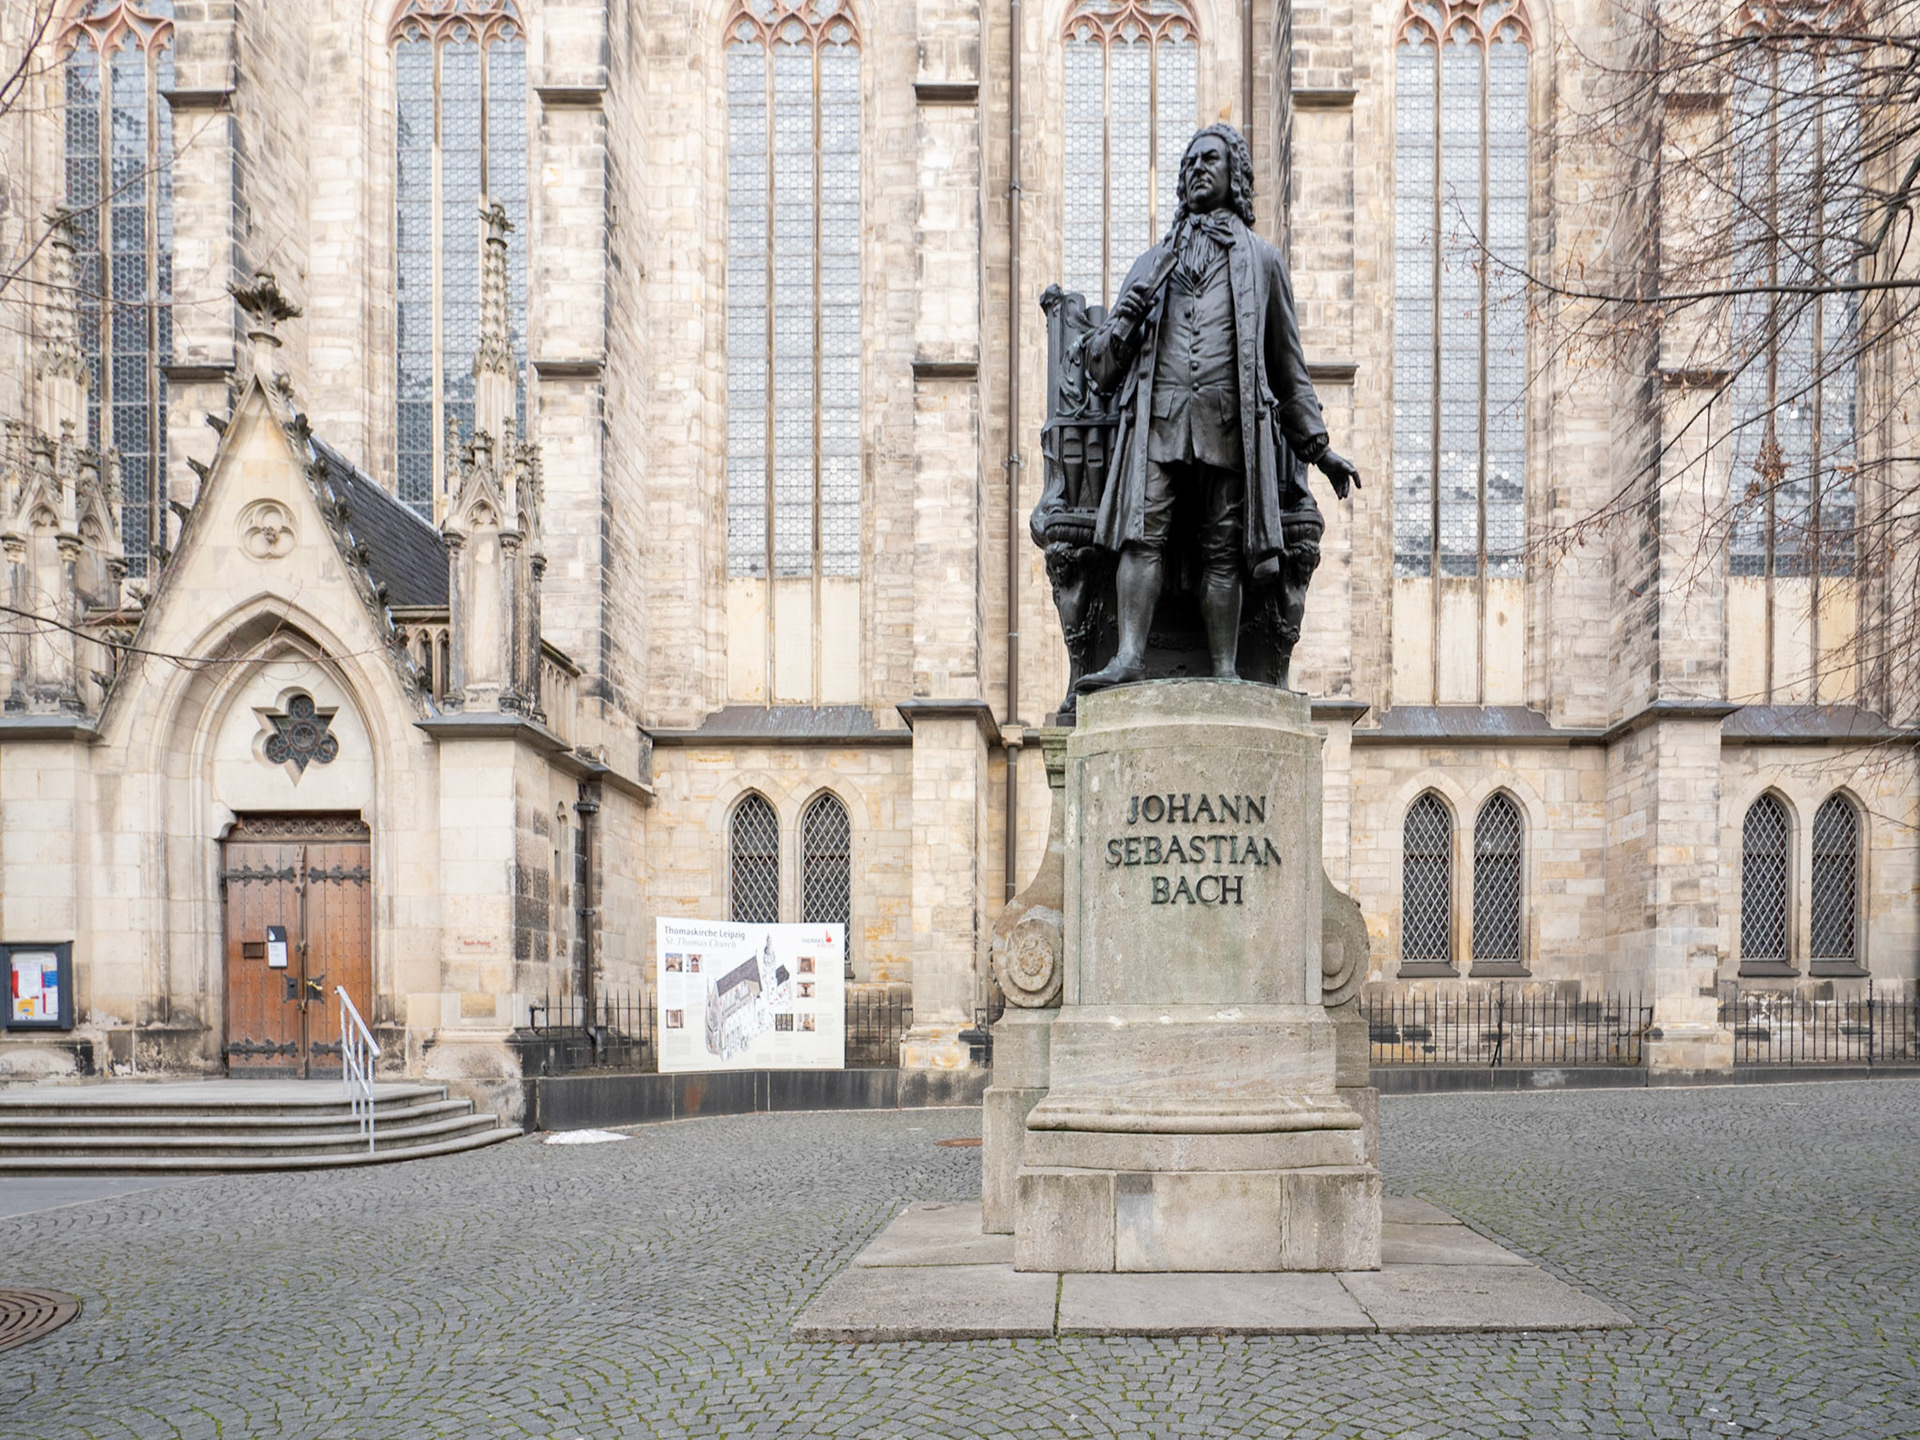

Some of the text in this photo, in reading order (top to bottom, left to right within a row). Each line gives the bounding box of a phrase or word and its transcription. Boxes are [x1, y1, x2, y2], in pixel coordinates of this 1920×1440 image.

[1127, 793, 1267, 825] JOHANN
[1104, 834, 1282, 868] SEBASTIAN
[1150, 874, 1244, 905] BACH
[664, 925, 746, 941] Thomaskirche Leipzig
[664, 937, 737, 949] St. Thomas Church
